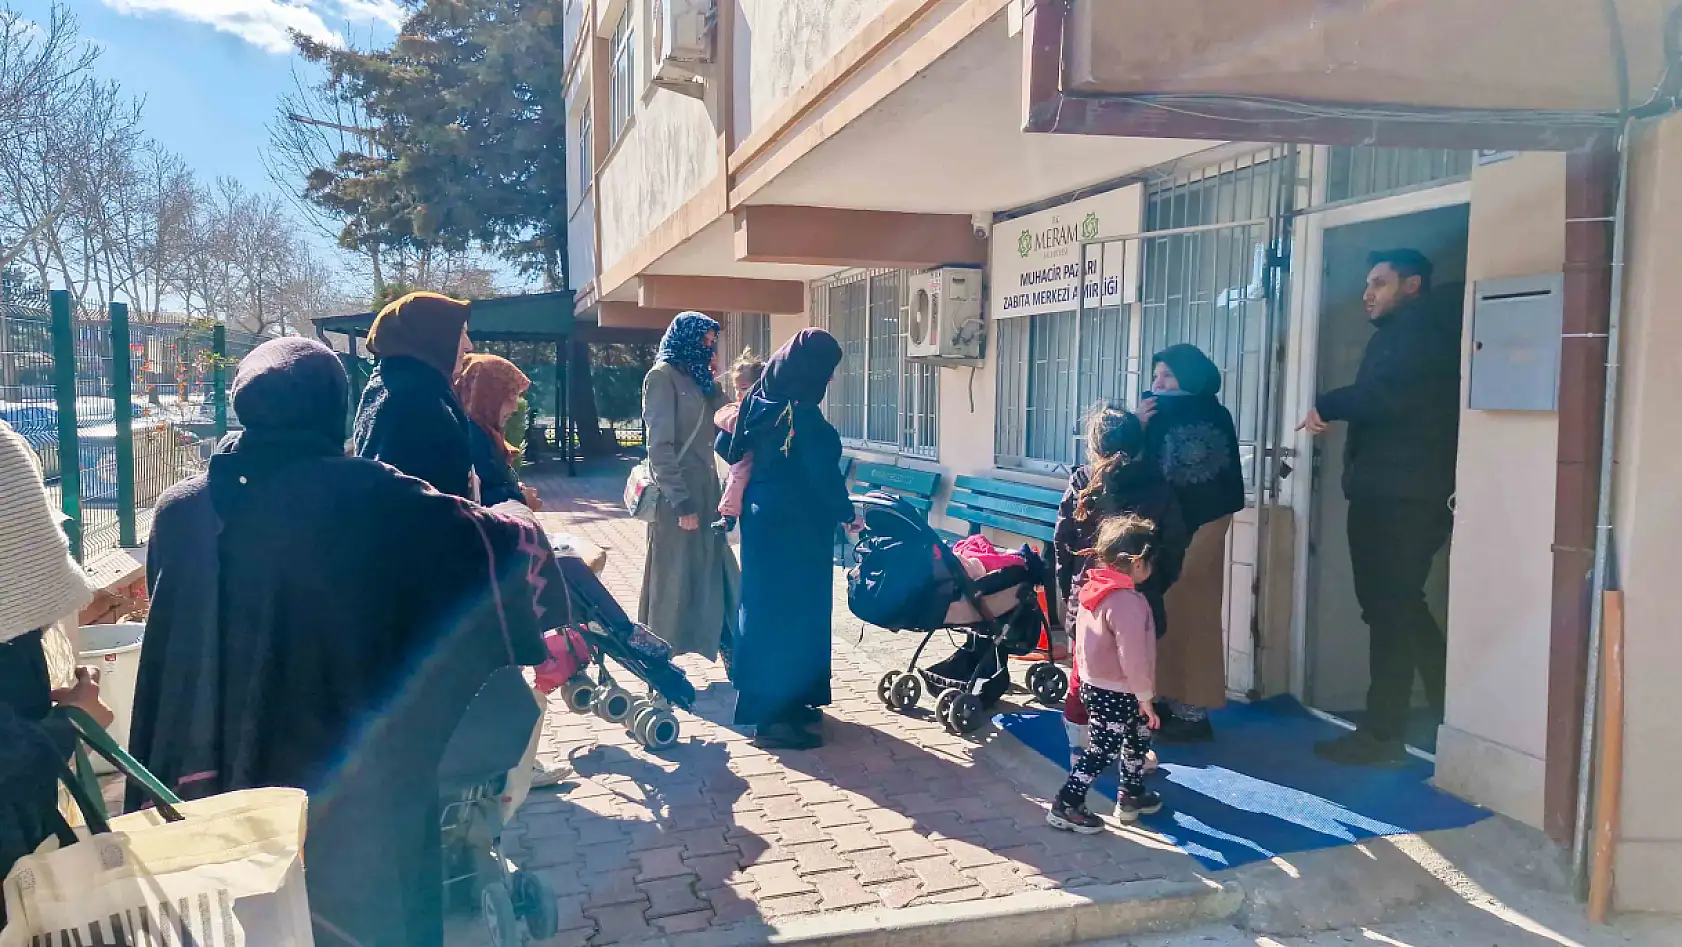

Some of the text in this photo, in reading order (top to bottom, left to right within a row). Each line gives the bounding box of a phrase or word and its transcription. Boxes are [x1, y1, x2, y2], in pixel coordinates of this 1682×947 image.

[1034, 222, 1079, 251] MERAM
[1020, 259, 1097, 287] MUHACİR PAZRI
[1003, 291, 1031, 310] ZABITA
[1032, 283, 1070, 306] MERKEZİ
